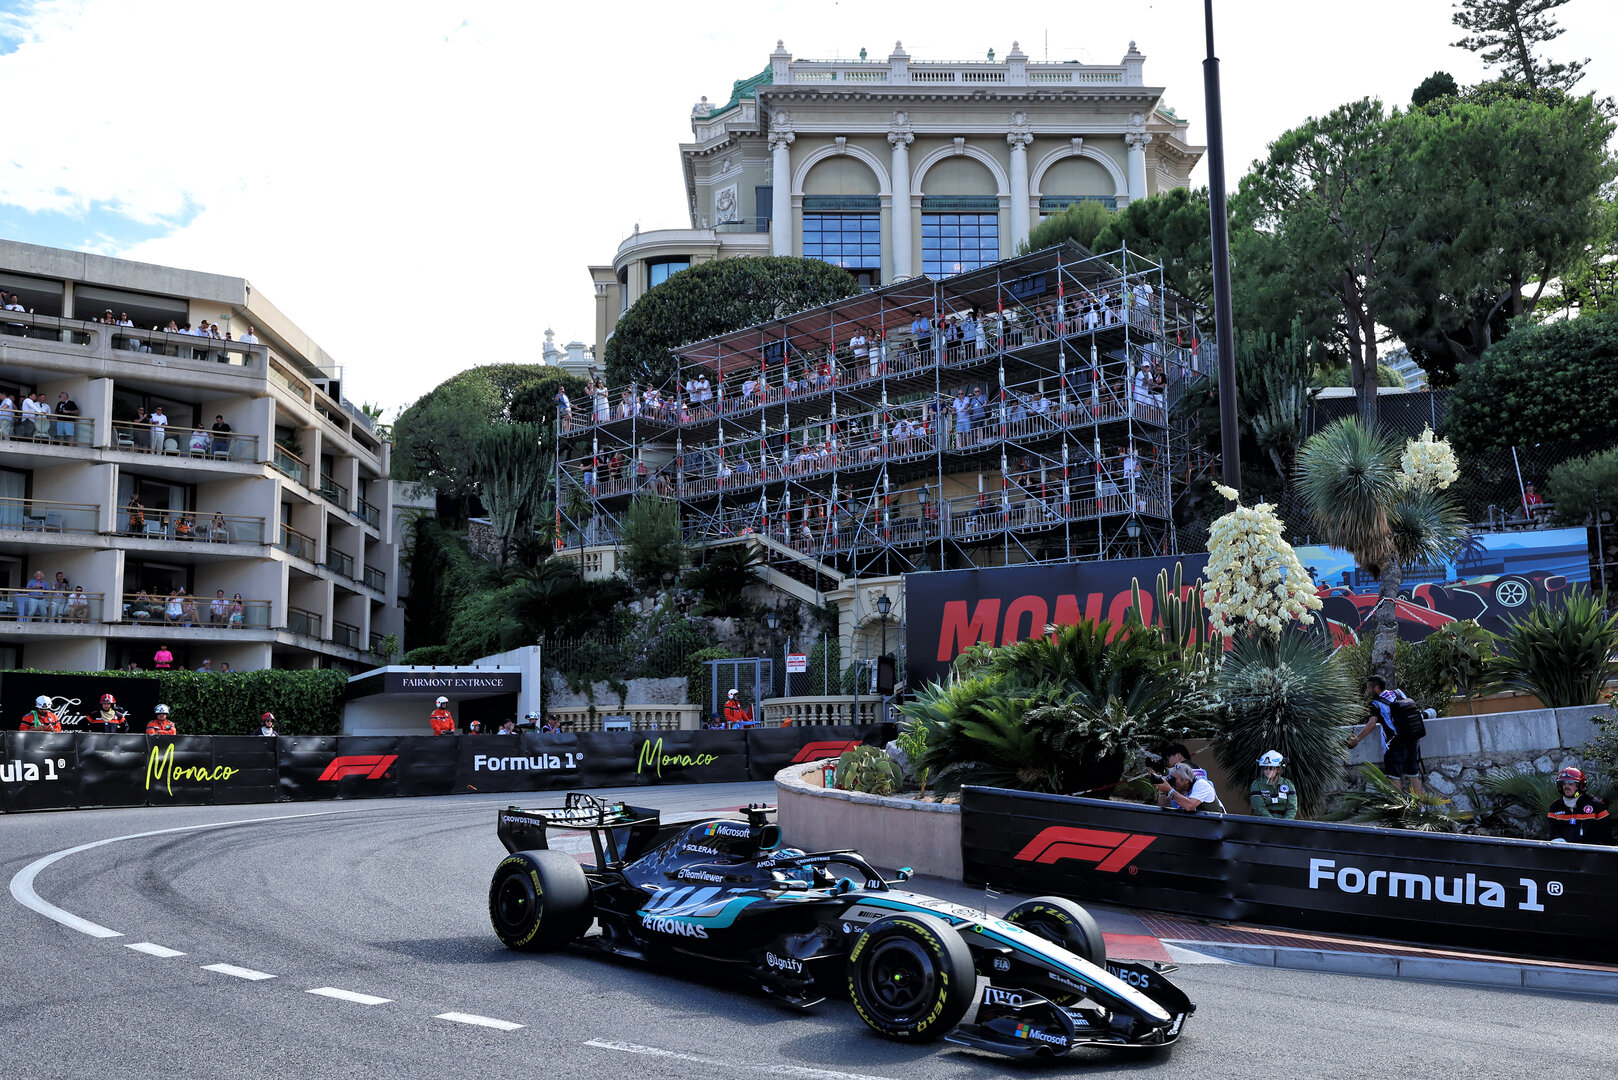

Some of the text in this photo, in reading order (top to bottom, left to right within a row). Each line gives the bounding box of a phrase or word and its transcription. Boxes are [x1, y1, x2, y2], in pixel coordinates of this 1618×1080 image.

[403, 678, 503, 687] FAIRMONT ENTRANCE
[474, 753, 560, 771] Formula
[637, 737, 718, 778] Monaco
[145, 742, 239, 796] Monaco
[503, 815, 541, 827] CROWDSTRIKE
[716, 825, 750, 839] Microsoft
[686, 843, 713, 855] SOLERA
[756, 861, 772, 869] AMD
[684, 871, 724, 883] TeamViewer
[1309, 858, 1505, 908] Formula
[642, 913, 709, 939] PETRONAS
[995, 960, 1010, 970] FIA
[1107, 965, 1149, 989] INEOS
[984, 987, 1022, 1011] IWC
[917, 987, 947, 1032] ZERO
[1029, 1028, 1067, 1046] Microsoft
